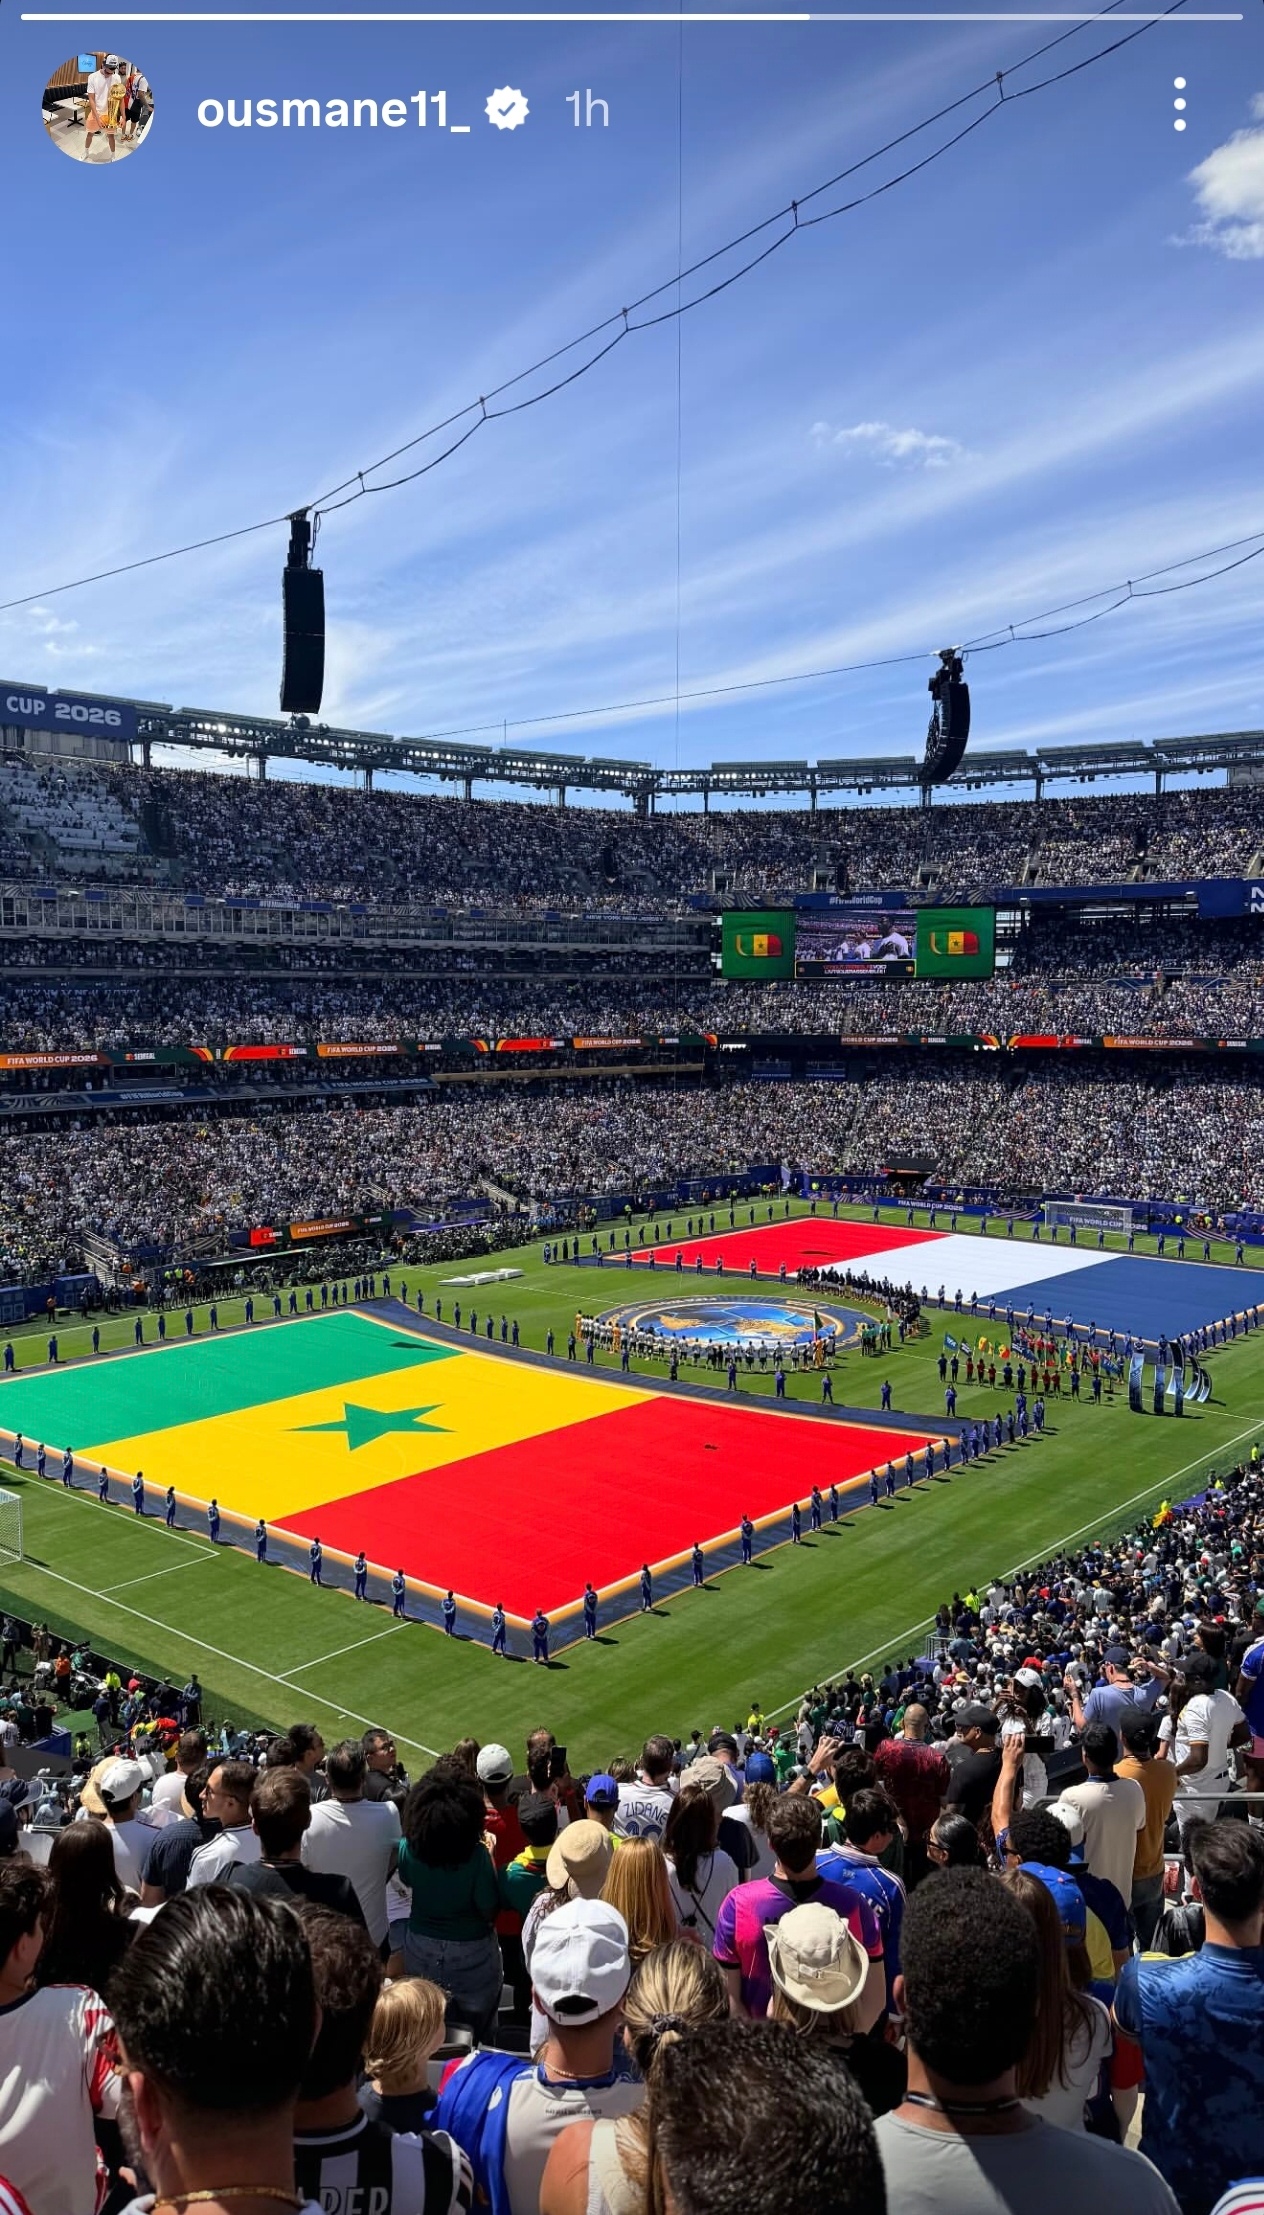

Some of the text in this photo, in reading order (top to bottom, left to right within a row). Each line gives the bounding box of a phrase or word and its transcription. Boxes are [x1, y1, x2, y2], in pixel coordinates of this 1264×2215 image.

[6, 695, 122, 726] CUP 2026
[7, 1054, 99, 1065] FIFA WORLD CUP 2026
[911, 1200, 931, 1208] WORLD
[931, 1202, 944, 1210] CUP
[1069, 1216, 1084, 1224] FIFA
[1084, 1218, 1108, 1227] WORLD
[1108, 1220, 1123, 1228] CUP
[623, 1801, 669, 1825] ZIDANE
